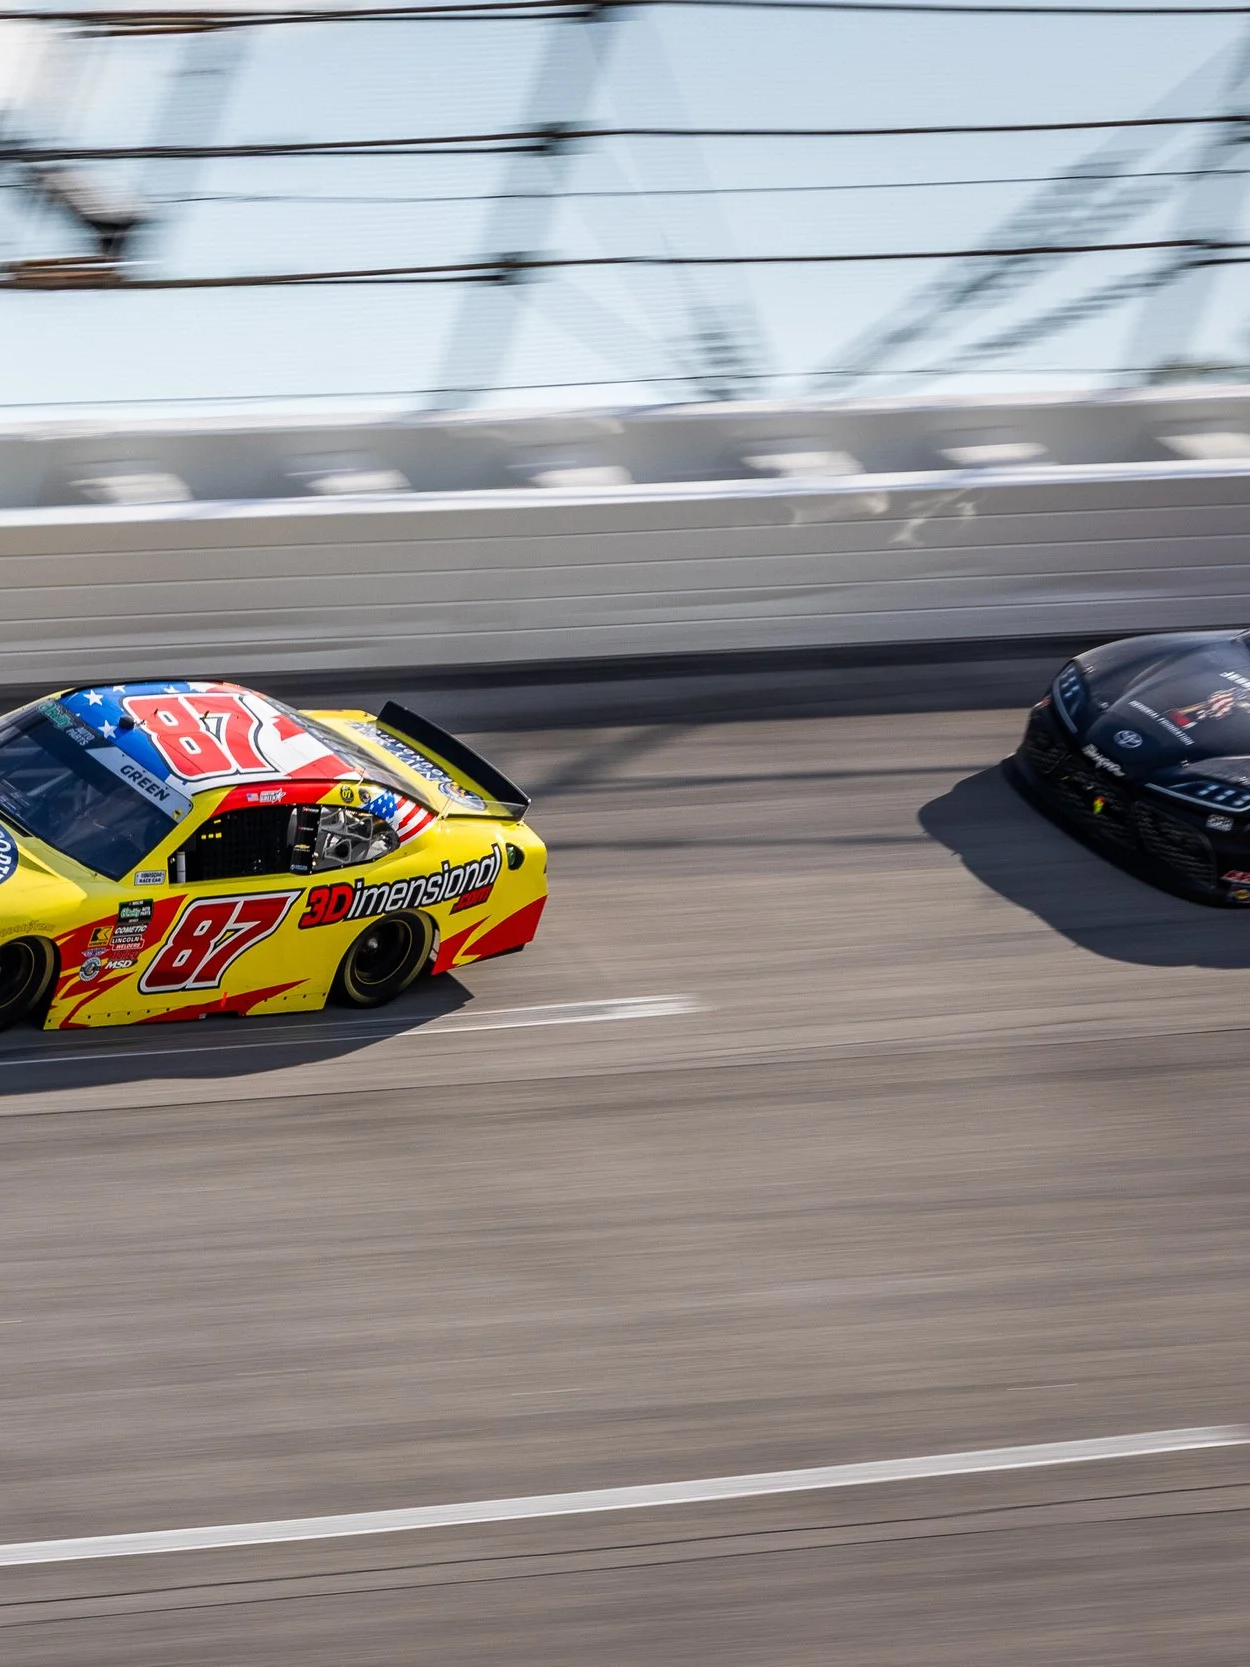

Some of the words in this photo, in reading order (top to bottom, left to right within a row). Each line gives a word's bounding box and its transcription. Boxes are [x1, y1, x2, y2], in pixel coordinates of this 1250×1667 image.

[65, 728, 89, 746] PARTS
[75, 726, 95, 740] AUTO
[121, 693, 278, 782] 87
[120, 764, 170, 801] GREEN
[299, 844, 501, 929] 3Dimensional
[114, 925, 147, 935] COMETIC
[112, 936, 140, 944] LINCOLN
[116, 942, 141, 950] WELDERS
[138, 888, 306, 994] 87
[105, 959, 132, 970] MSD
